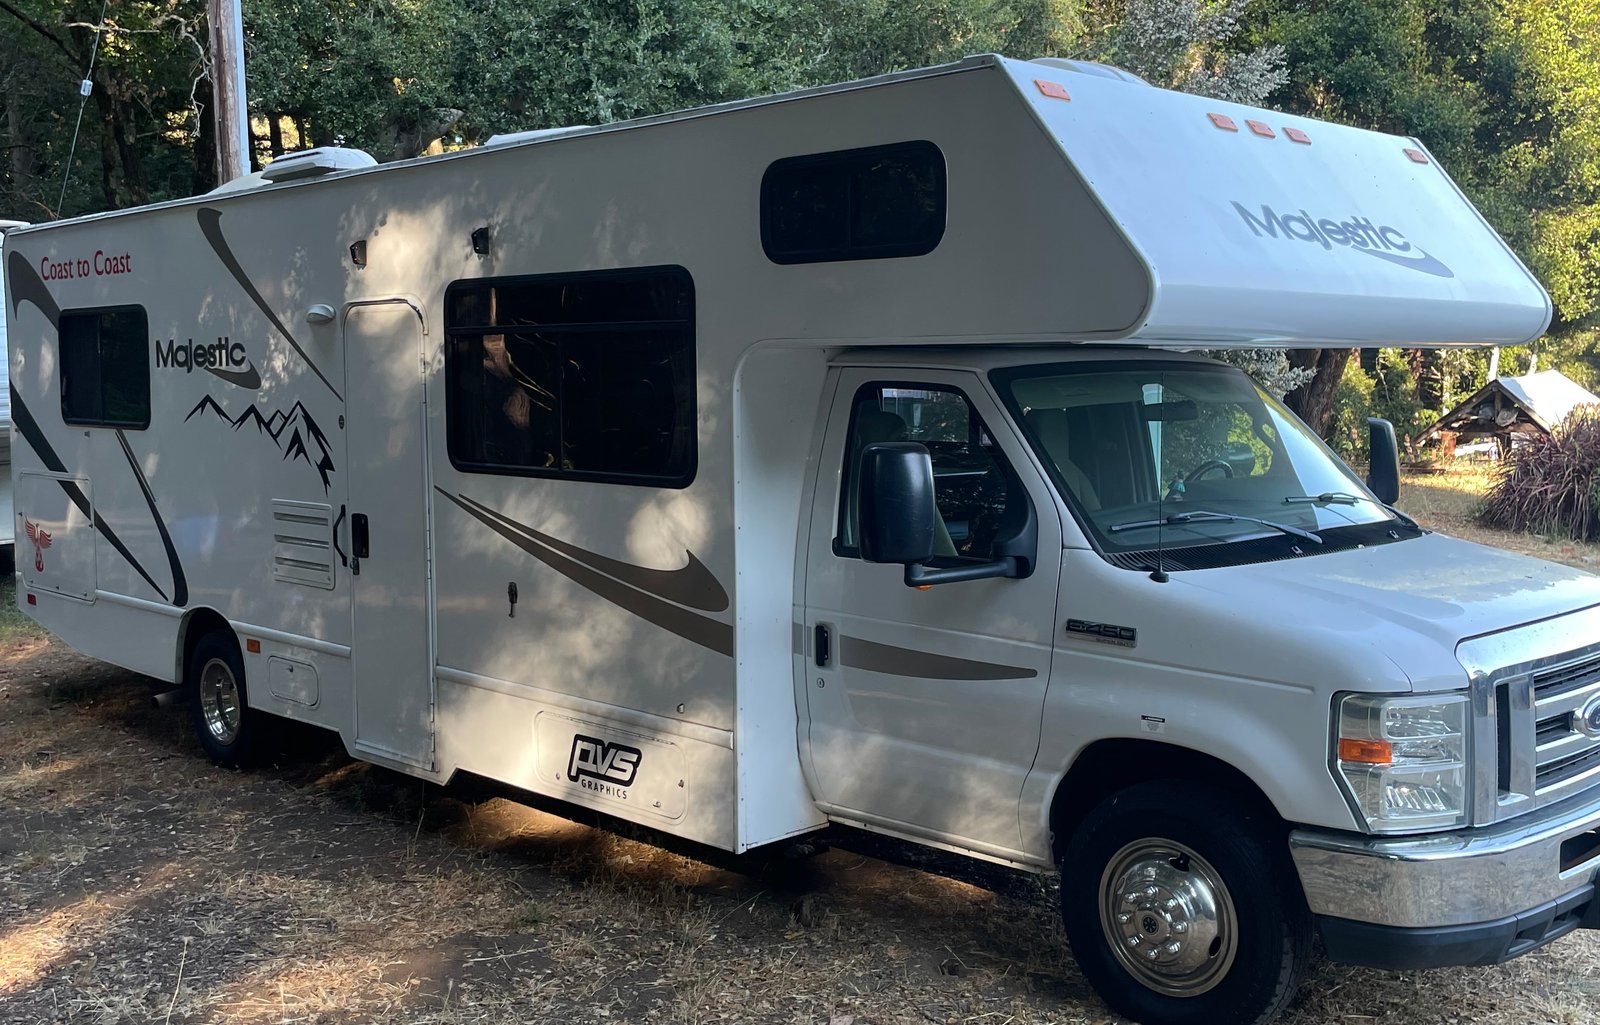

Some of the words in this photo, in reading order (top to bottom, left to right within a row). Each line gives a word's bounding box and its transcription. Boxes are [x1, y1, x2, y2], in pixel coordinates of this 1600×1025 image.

[1230, 200, 1411, 252] Majestic
[41, 256, 73, 281] Coast
[77, 258, 90, 278] to
[94, 249, 131, 276] Coast
[155, 336, 247, 374] Majestic
[581, 778, 627, 799] GRAPHICS
